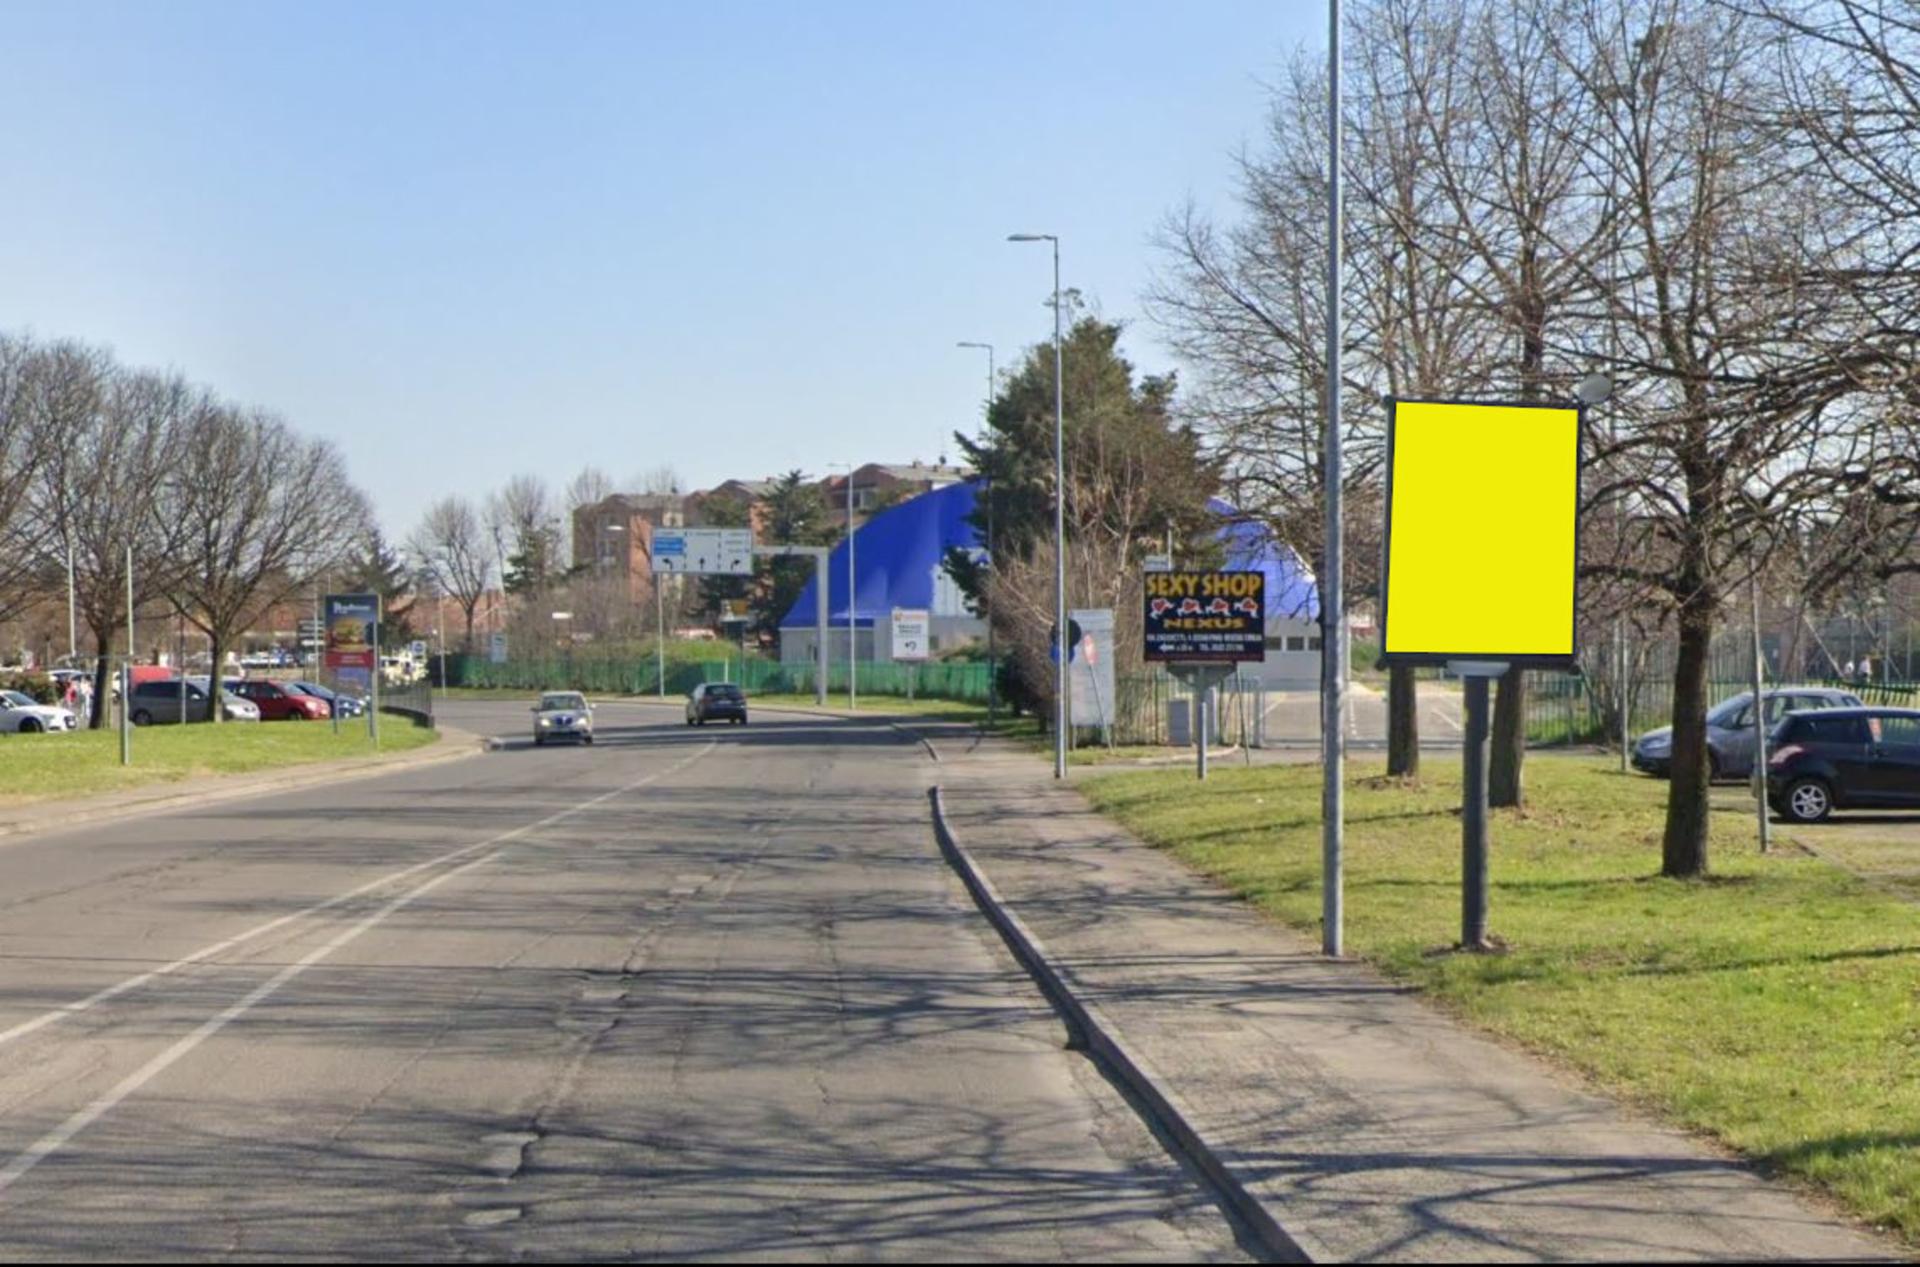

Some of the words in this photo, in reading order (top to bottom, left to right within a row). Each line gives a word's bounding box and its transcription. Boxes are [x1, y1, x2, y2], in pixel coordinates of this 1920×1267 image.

[1146, 574, 1198, 596] SEXY
[1202, 573, 1261, 596] SHOP
[1163, 618, 1244, 629] NEXUS
